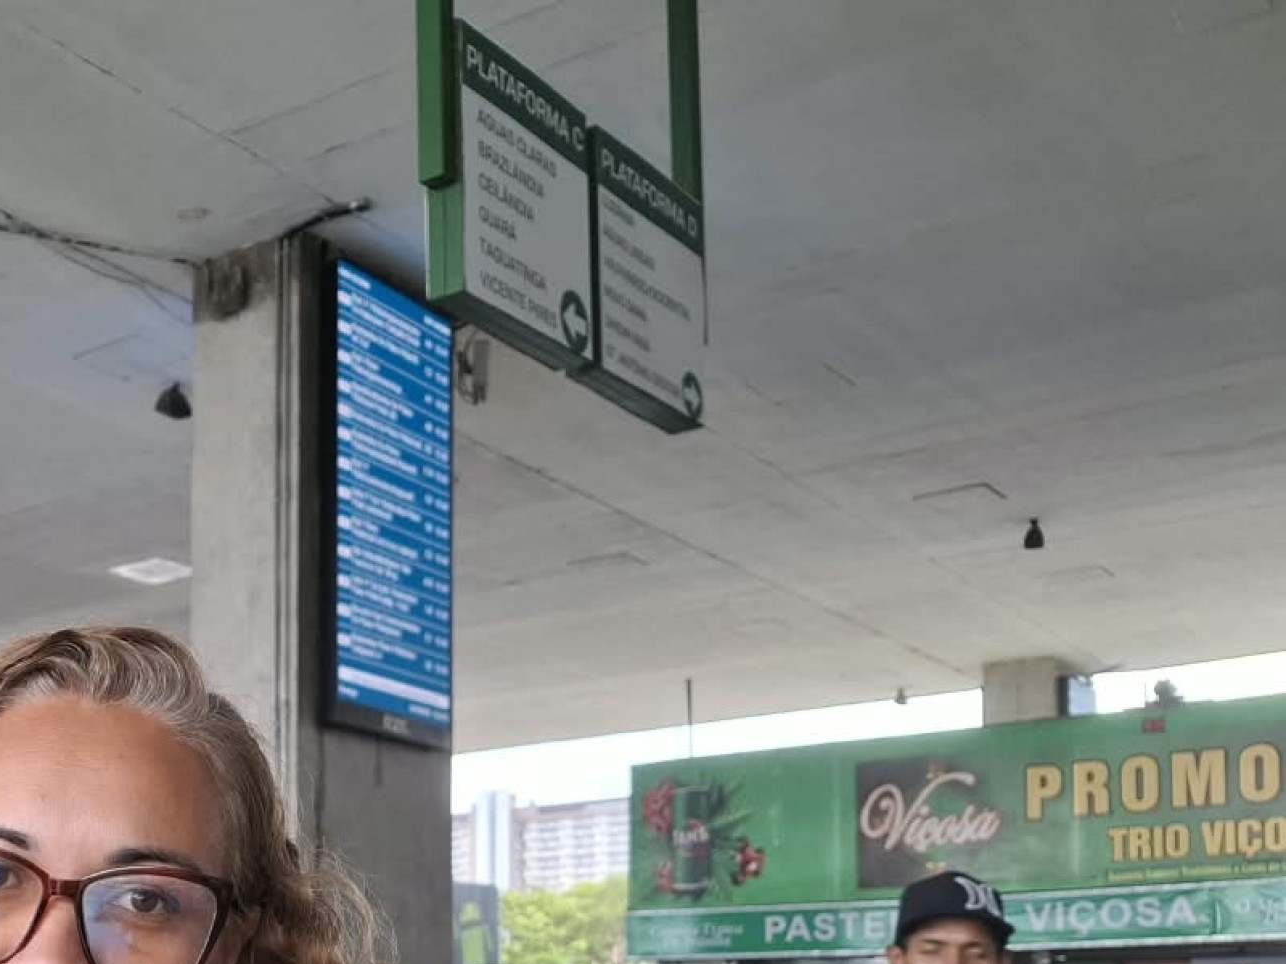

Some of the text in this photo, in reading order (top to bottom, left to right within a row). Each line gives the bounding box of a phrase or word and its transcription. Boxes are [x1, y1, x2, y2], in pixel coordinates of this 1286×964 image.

[467, 44, 571, 144] PLATAFORMA
[602, 148, 686, 232] PLATAFORMA
[859, 771, 1002, 852] Viçosa
[1107, 822, 1191, 863] TRIO
[1024, 895, 1198, 936] VIÇOSA
